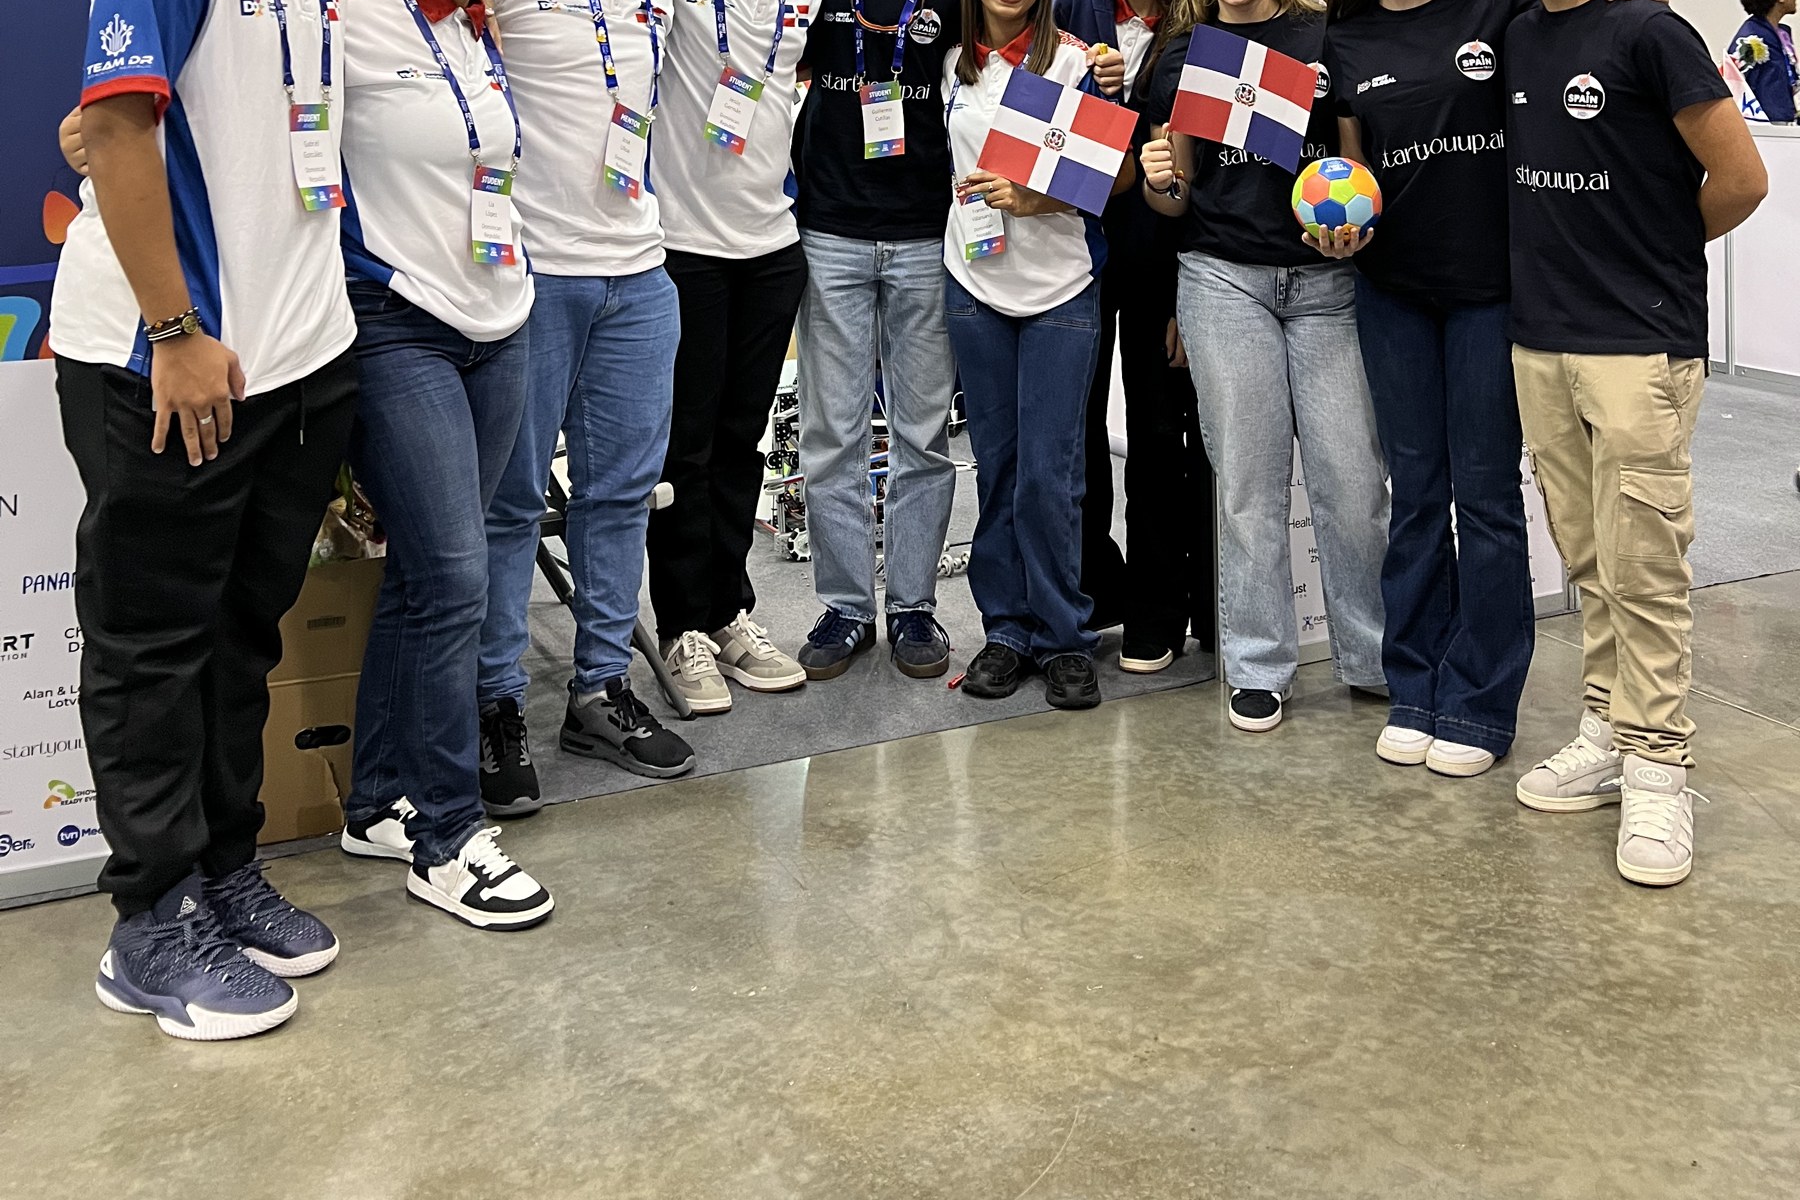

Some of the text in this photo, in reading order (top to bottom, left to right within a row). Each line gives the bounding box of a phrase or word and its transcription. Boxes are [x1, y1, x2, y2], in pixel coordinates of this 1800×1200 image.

[912, 22, 938, 34] SPAIN
[86, 56, 125, 75] TEAM
[127, 55, 154, 65] DR
[1461, 54, 1493, 68] SPAIN
[729, 76, 753, 92] STUDENT
[869, 89, 892, 99] STUDENT
[1567, 90, 1599, 105] SPAIN
[620, 113, 641, 130] MENTOR
[481, 175, 505, 187] STUDENT
[23, 688, 53, 701] Alan
[57, 686, 66, 696] &
